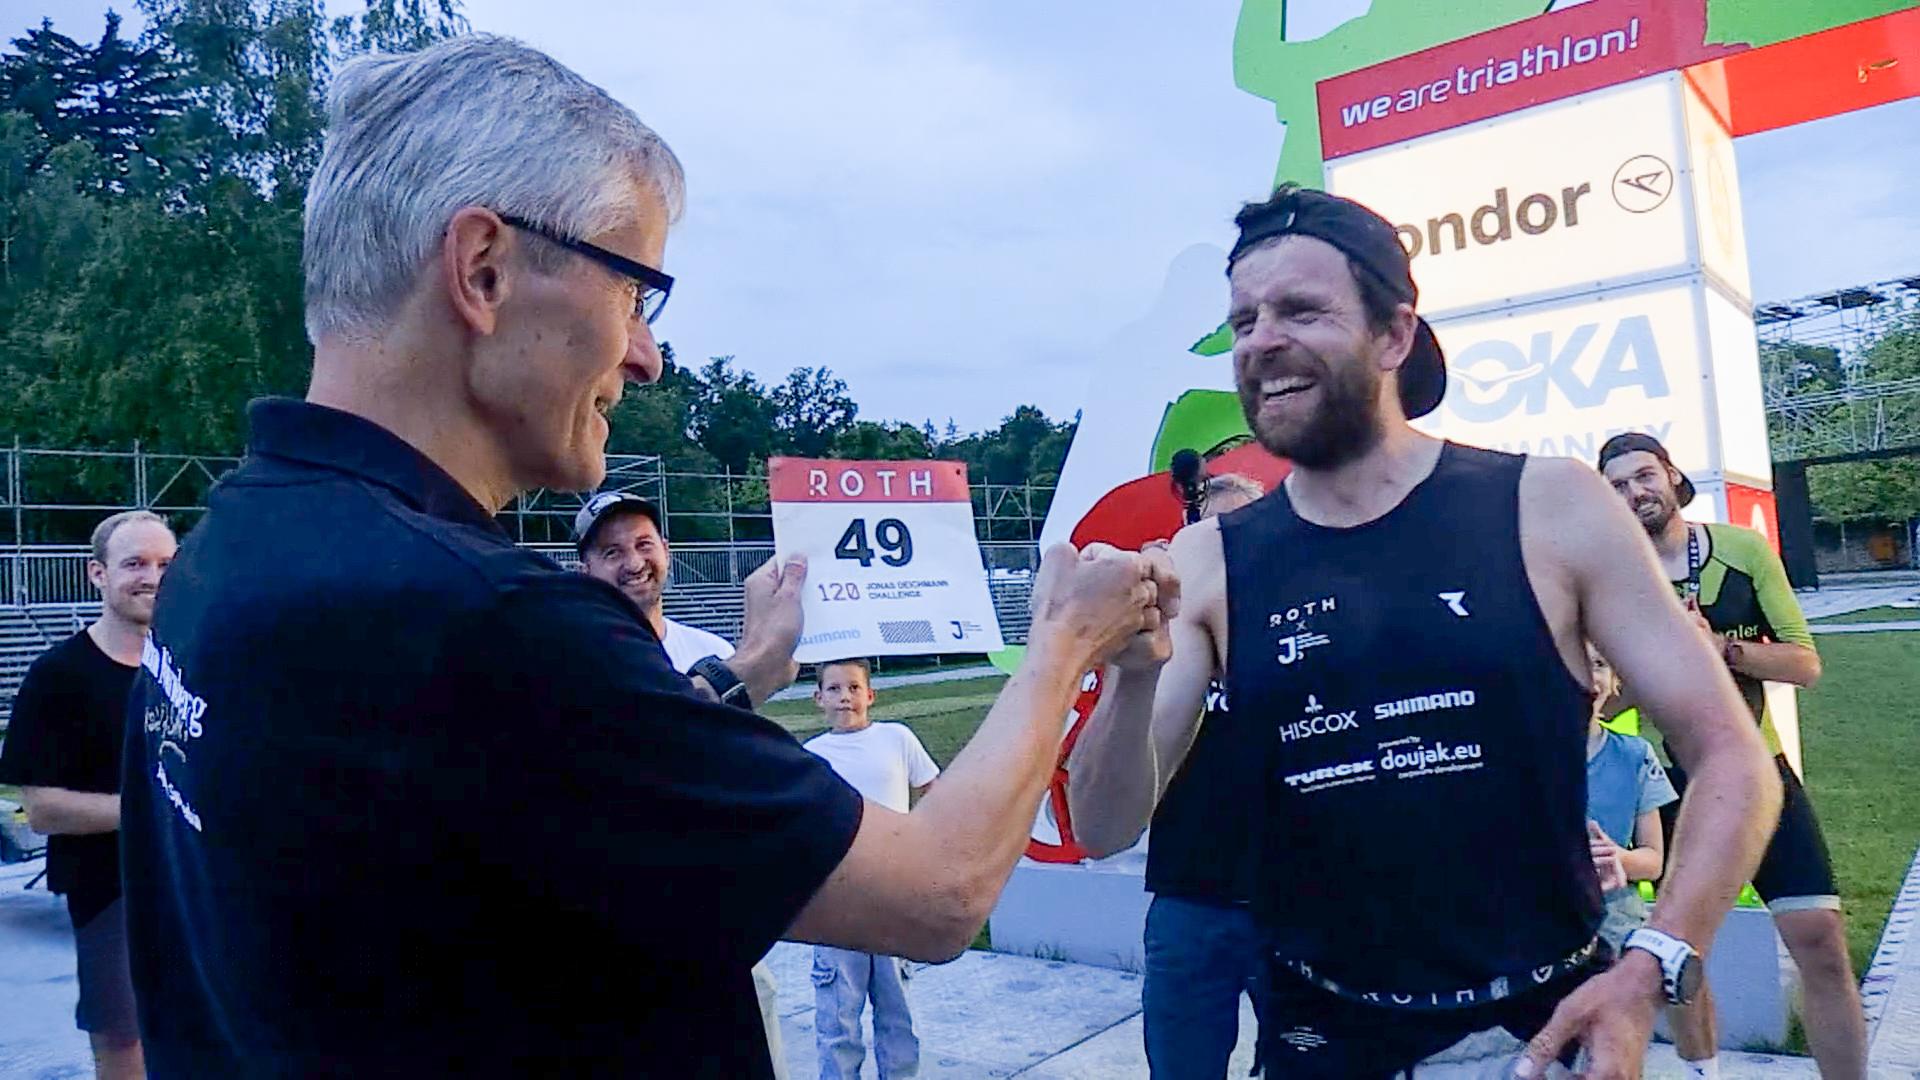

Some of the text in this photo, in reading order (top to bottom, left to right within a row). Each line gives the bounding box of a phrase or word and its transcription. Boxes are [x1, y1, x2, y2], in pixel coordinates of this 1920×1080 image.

[1340, 18, 1640, 127] we are triathlon!
[1396, 181, 1591, 261] ondor
[1422, 314, 1671, 429] OKA
[809, 469, 933, 498] ROTH
[834, 518, 914, 568] 49
[818, 582, 861, 602] 120
[1269, 597, 1336, 628] ROTH
[1374, 690, 1476, 720] SHIMANO
[1279, 710, 1361, 743] HISCOX
[1380, 742, 1482, 770] doujak.eu
